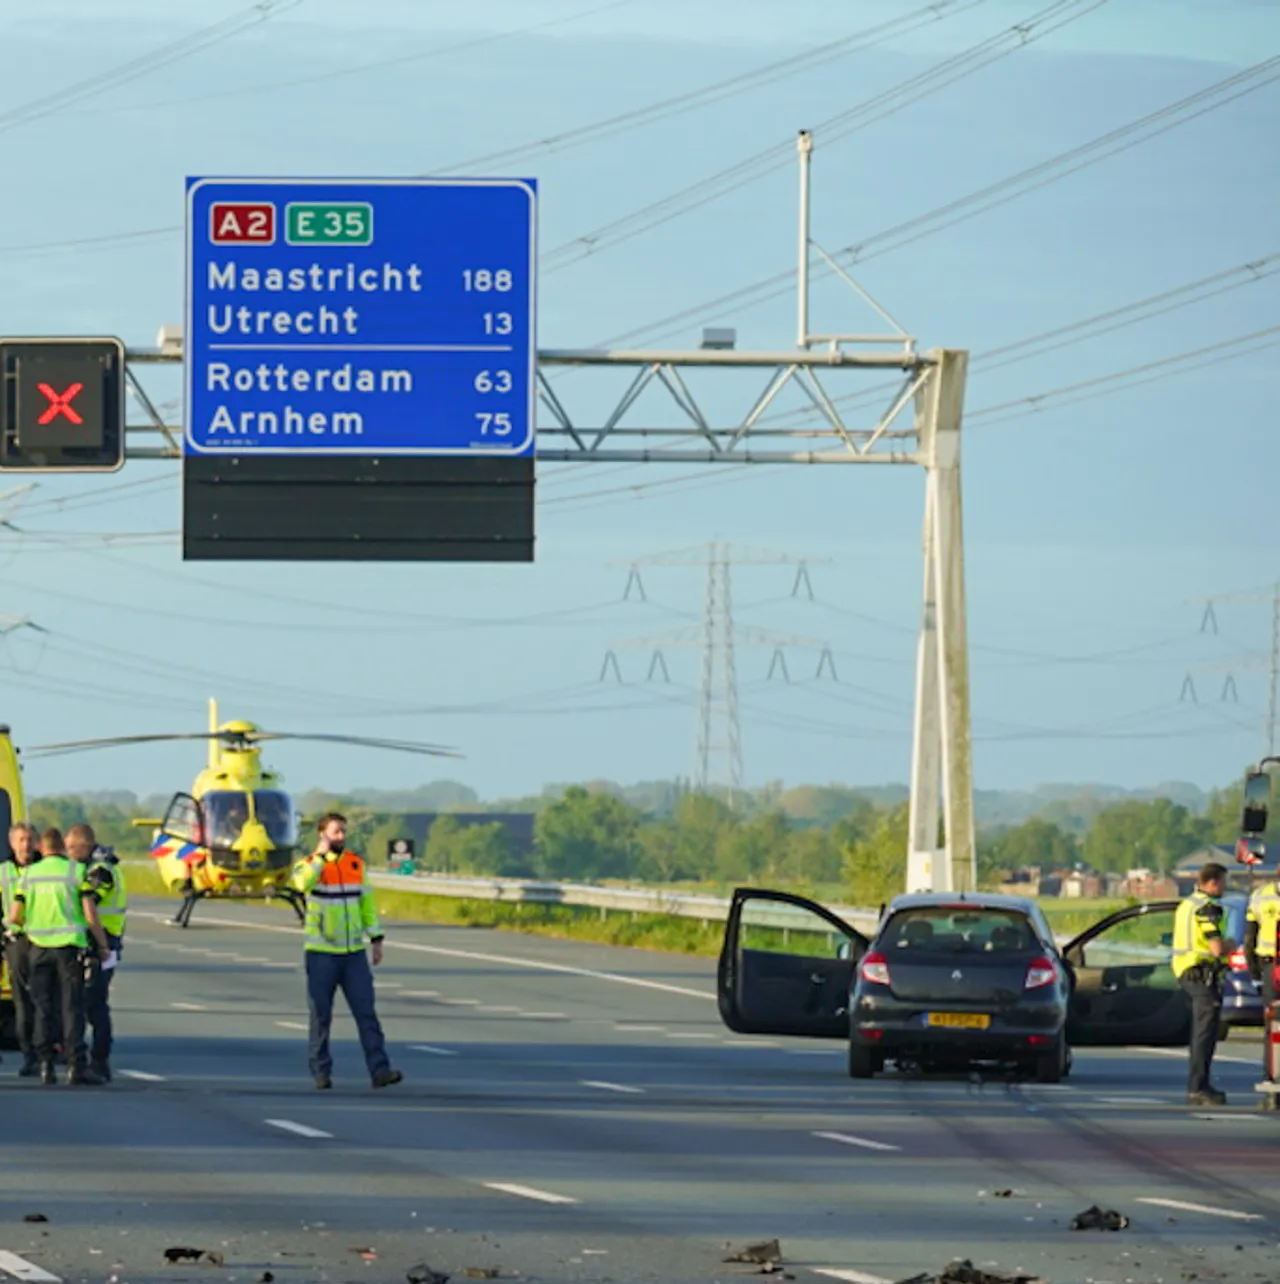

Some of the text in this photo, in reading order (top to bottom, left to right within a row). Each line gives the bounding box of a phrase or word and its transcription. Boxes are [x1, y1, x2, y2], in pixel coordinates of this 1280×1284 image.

[218, 211, 268, 237] A2
[208, 261, 513, 292] Maastricht 188
[208, 304, 513, 335] Utrecht 13
[207, 362, 513, 393] Rotterdam 63
[208, 405, 513, 435] Arnhem 75
